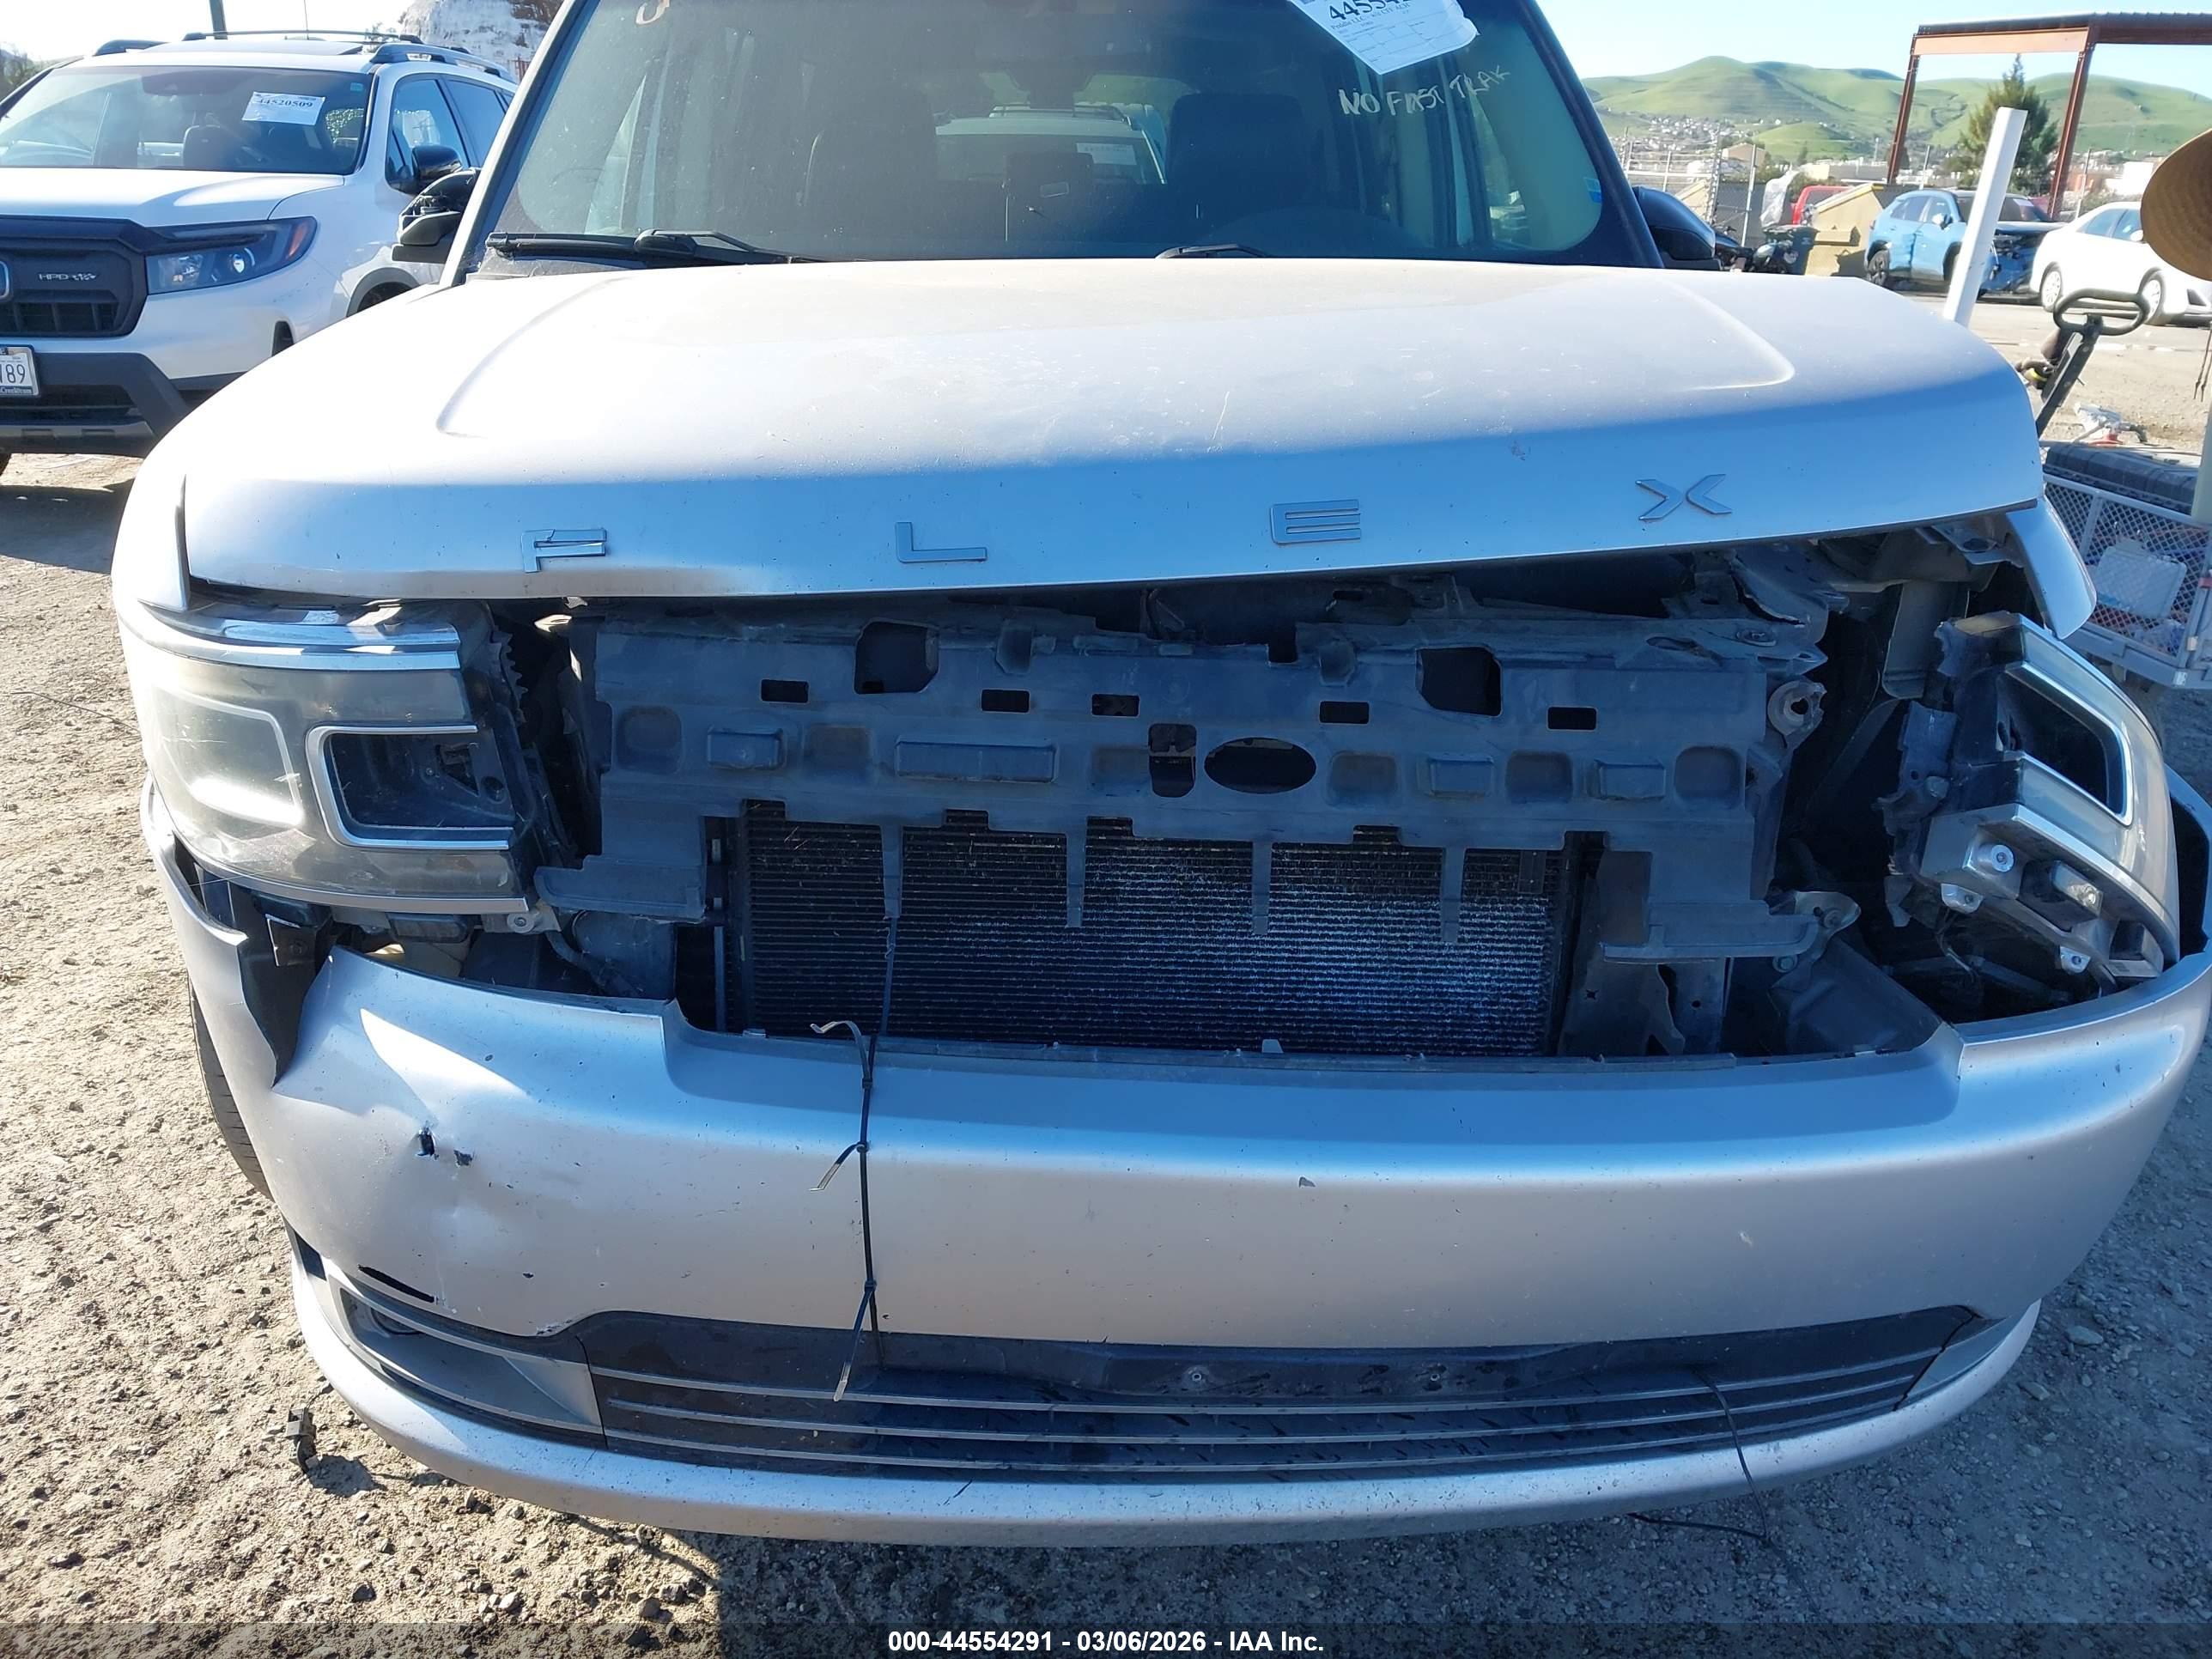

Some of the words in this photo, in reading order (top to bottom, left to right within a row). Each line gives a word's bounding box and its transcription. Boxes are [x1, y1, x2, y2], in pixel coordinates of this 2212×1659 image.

[1329, 0, 1410, 20] 4455
[1339, 88, 1381, 115] NO
[0, 363, 26, 384] 89
[520, 474, 1733, 573] FLEX
